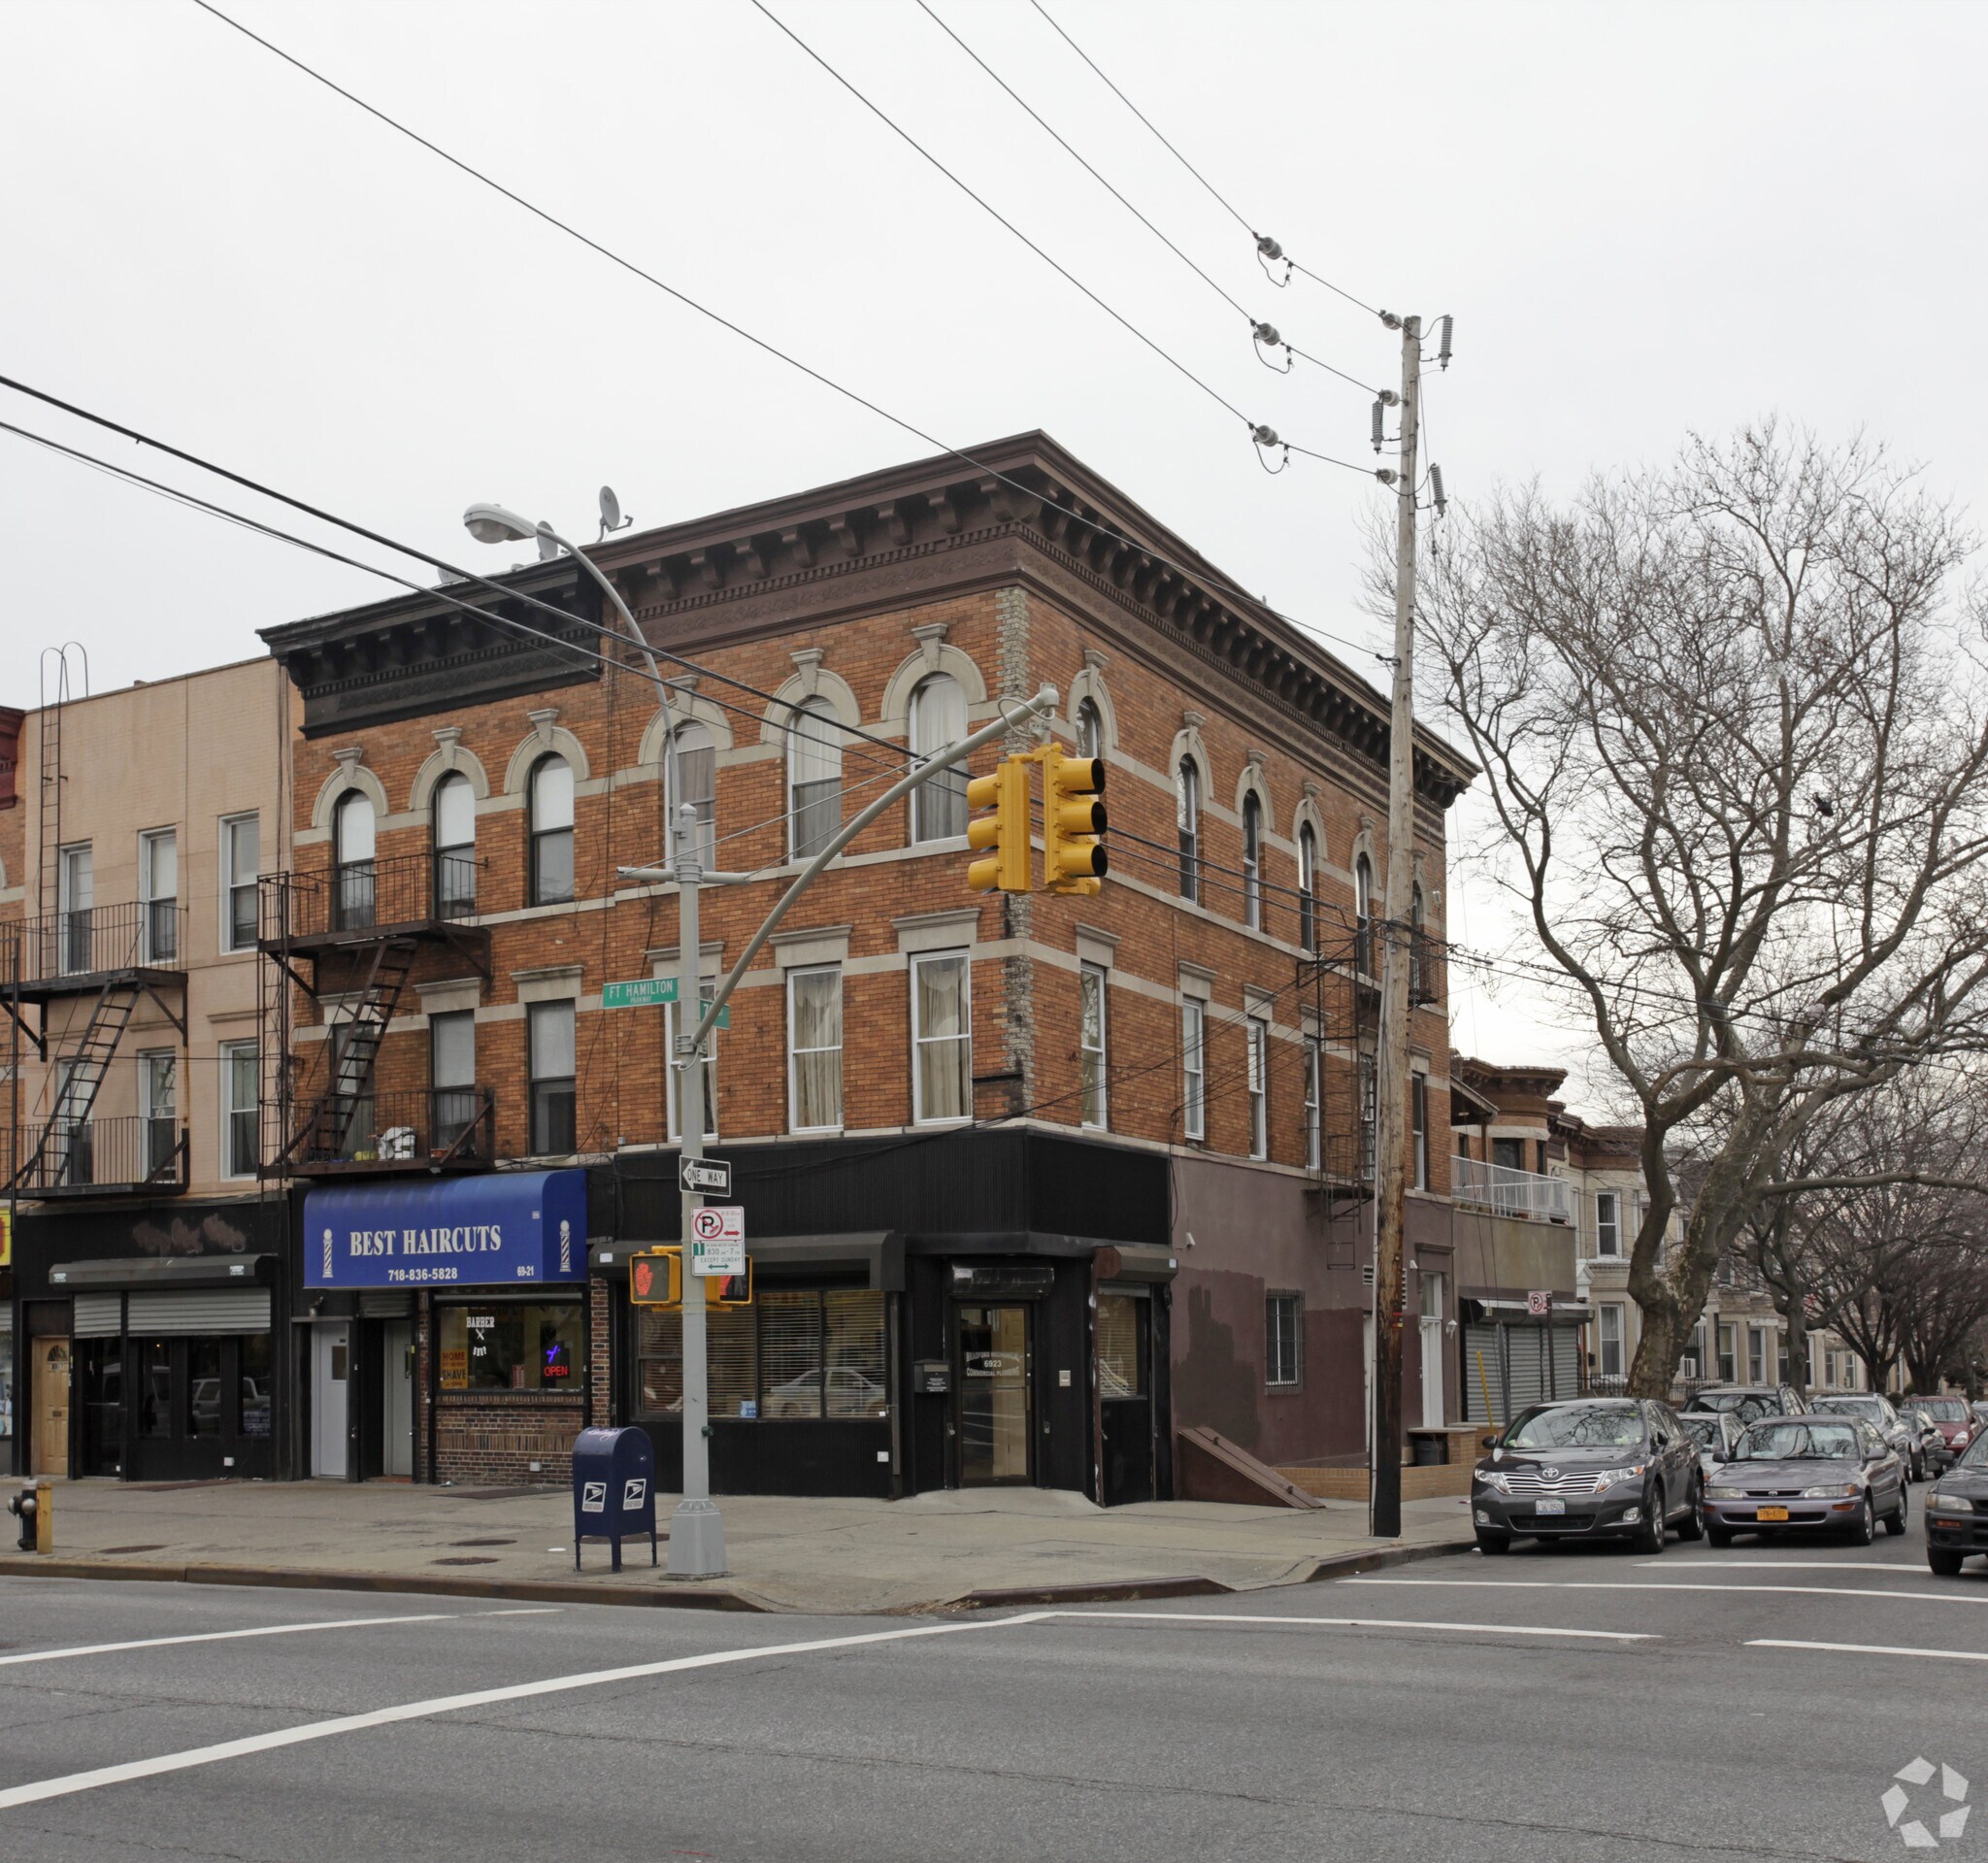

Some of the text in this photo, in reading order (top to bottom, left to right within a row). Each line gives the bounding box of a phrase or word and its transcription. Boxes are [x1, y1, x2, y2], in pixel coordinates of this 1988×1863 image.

[609, 980, 673, 999] FT HAMILTON
[687, 1168, 723, 1184] ONE WAY
[349, 1224, 502, 1256] BEST HAIRCUTS
[388, 1267, 458, 1281] 718-836-5828
[516, 1265, 534, 1277] 69-21
[466, 1316, 495, 1328] BARBER
[443, 1351, 465, 1361] HOME
[983, 1359, 1002, 1368] 6923
[442, 1368, 466, 1381] SHAVE
[544, 1365, 568, 1378] OPEN
